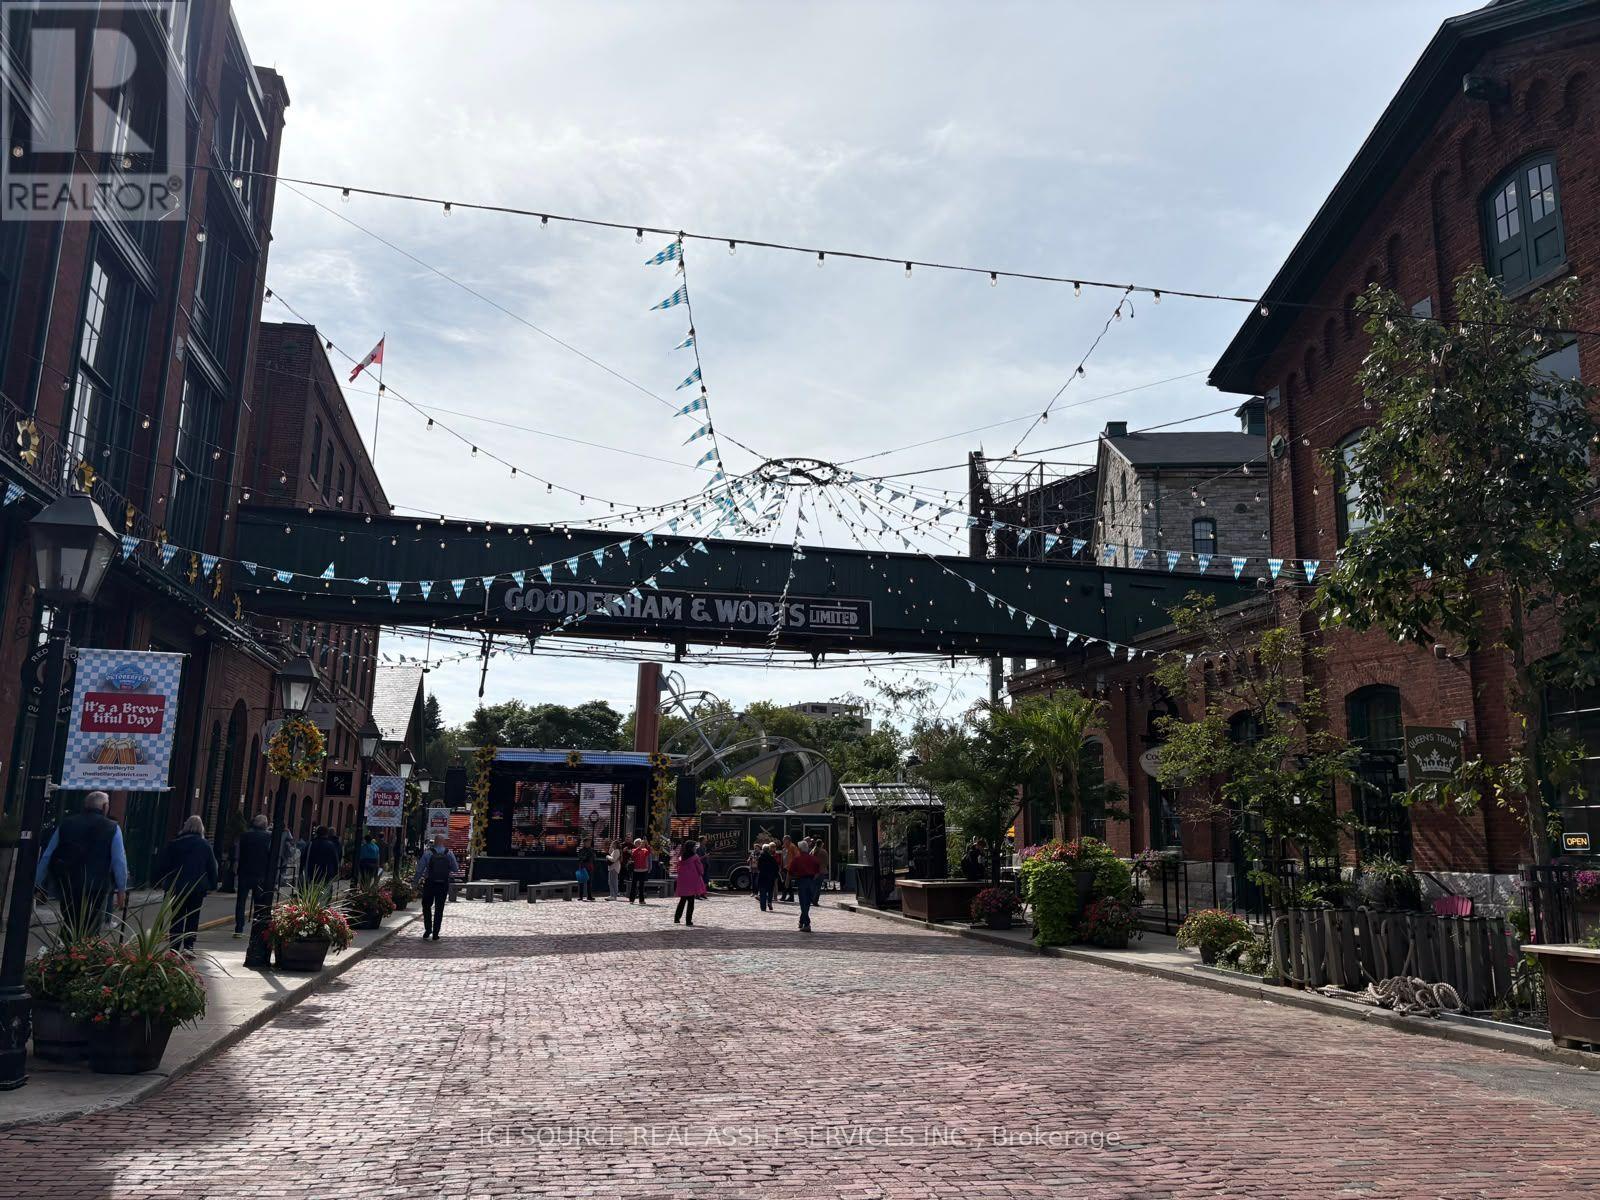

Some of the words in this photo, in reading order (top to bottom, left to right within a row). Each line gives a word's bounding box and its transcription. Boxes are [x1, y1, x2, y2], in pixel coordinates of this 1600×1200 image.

[504, 587, 683, 620] GOODERHAM
[690, 598, 712, 622] &
[715, 599, 805, 627] WORTS
[809, 610, 858, 625] LIMITED
[84, 701, 105, 712] It's
[110, 704, 118, 713] a
[122, 702, 164, 714] Brew-
[93, 712, 122, 724] tiful
[127, 713, 153, 727] Day
[1566, 837, 1588, 846] OPEN
